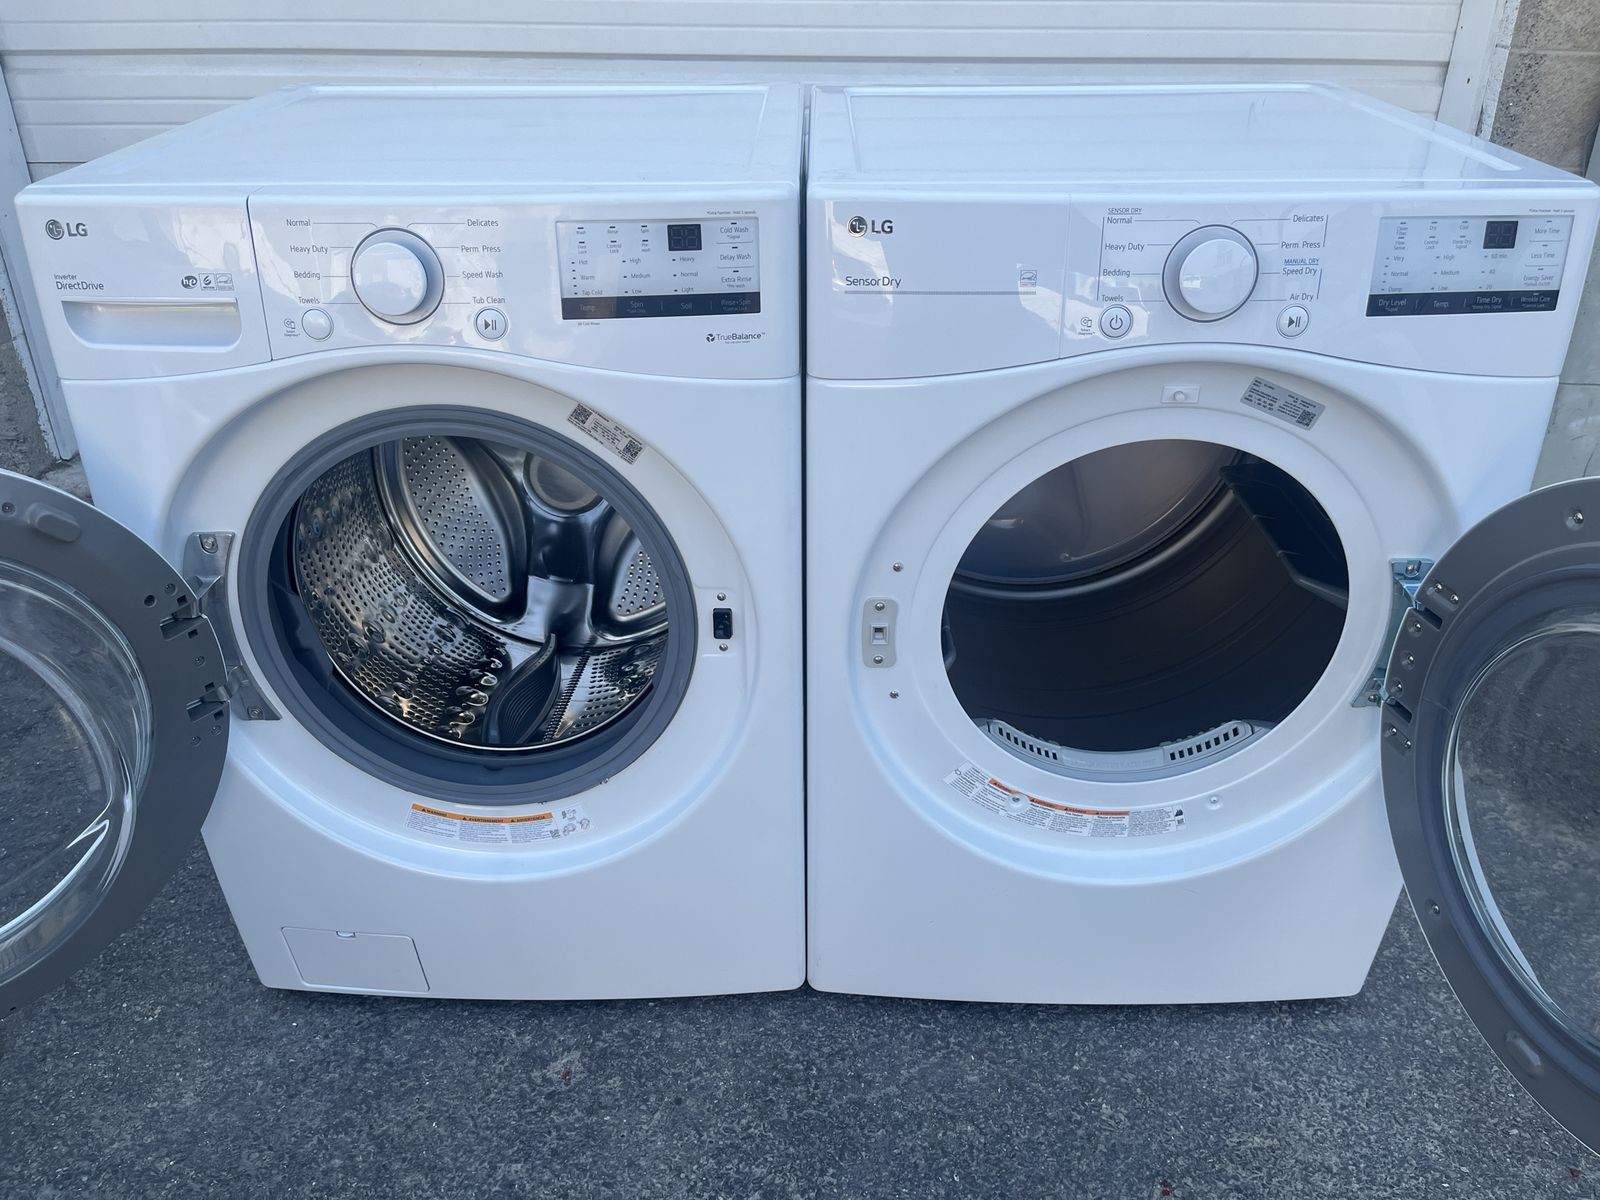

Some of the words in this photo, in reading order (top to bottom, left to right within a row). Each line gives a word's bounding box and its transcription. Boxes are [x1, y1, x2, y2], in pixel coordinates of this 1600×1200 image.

[1293, 214, 1324, 222] Delicates
[67, 222, 88, 237] LG
[872, 220, 893, 234] LG
[290, 245, 310, 254] Heavy
[312, 245, 328, 254] Duty
[1104, 242, 1126, 251] Heavy
[1128, 242, 1144, 251] Duty
[294, 270, 320, 280] Bedding
[462, 270, 483, 280] Speed
[485, 270, 504, 278] Wash
[1102, 269, 1130, 278] Bedding
[1282, 267, 1303, 276] Speed
[1305, 267, 1318, 276] Dry
[1302, 293, 1314, 302] Dry
